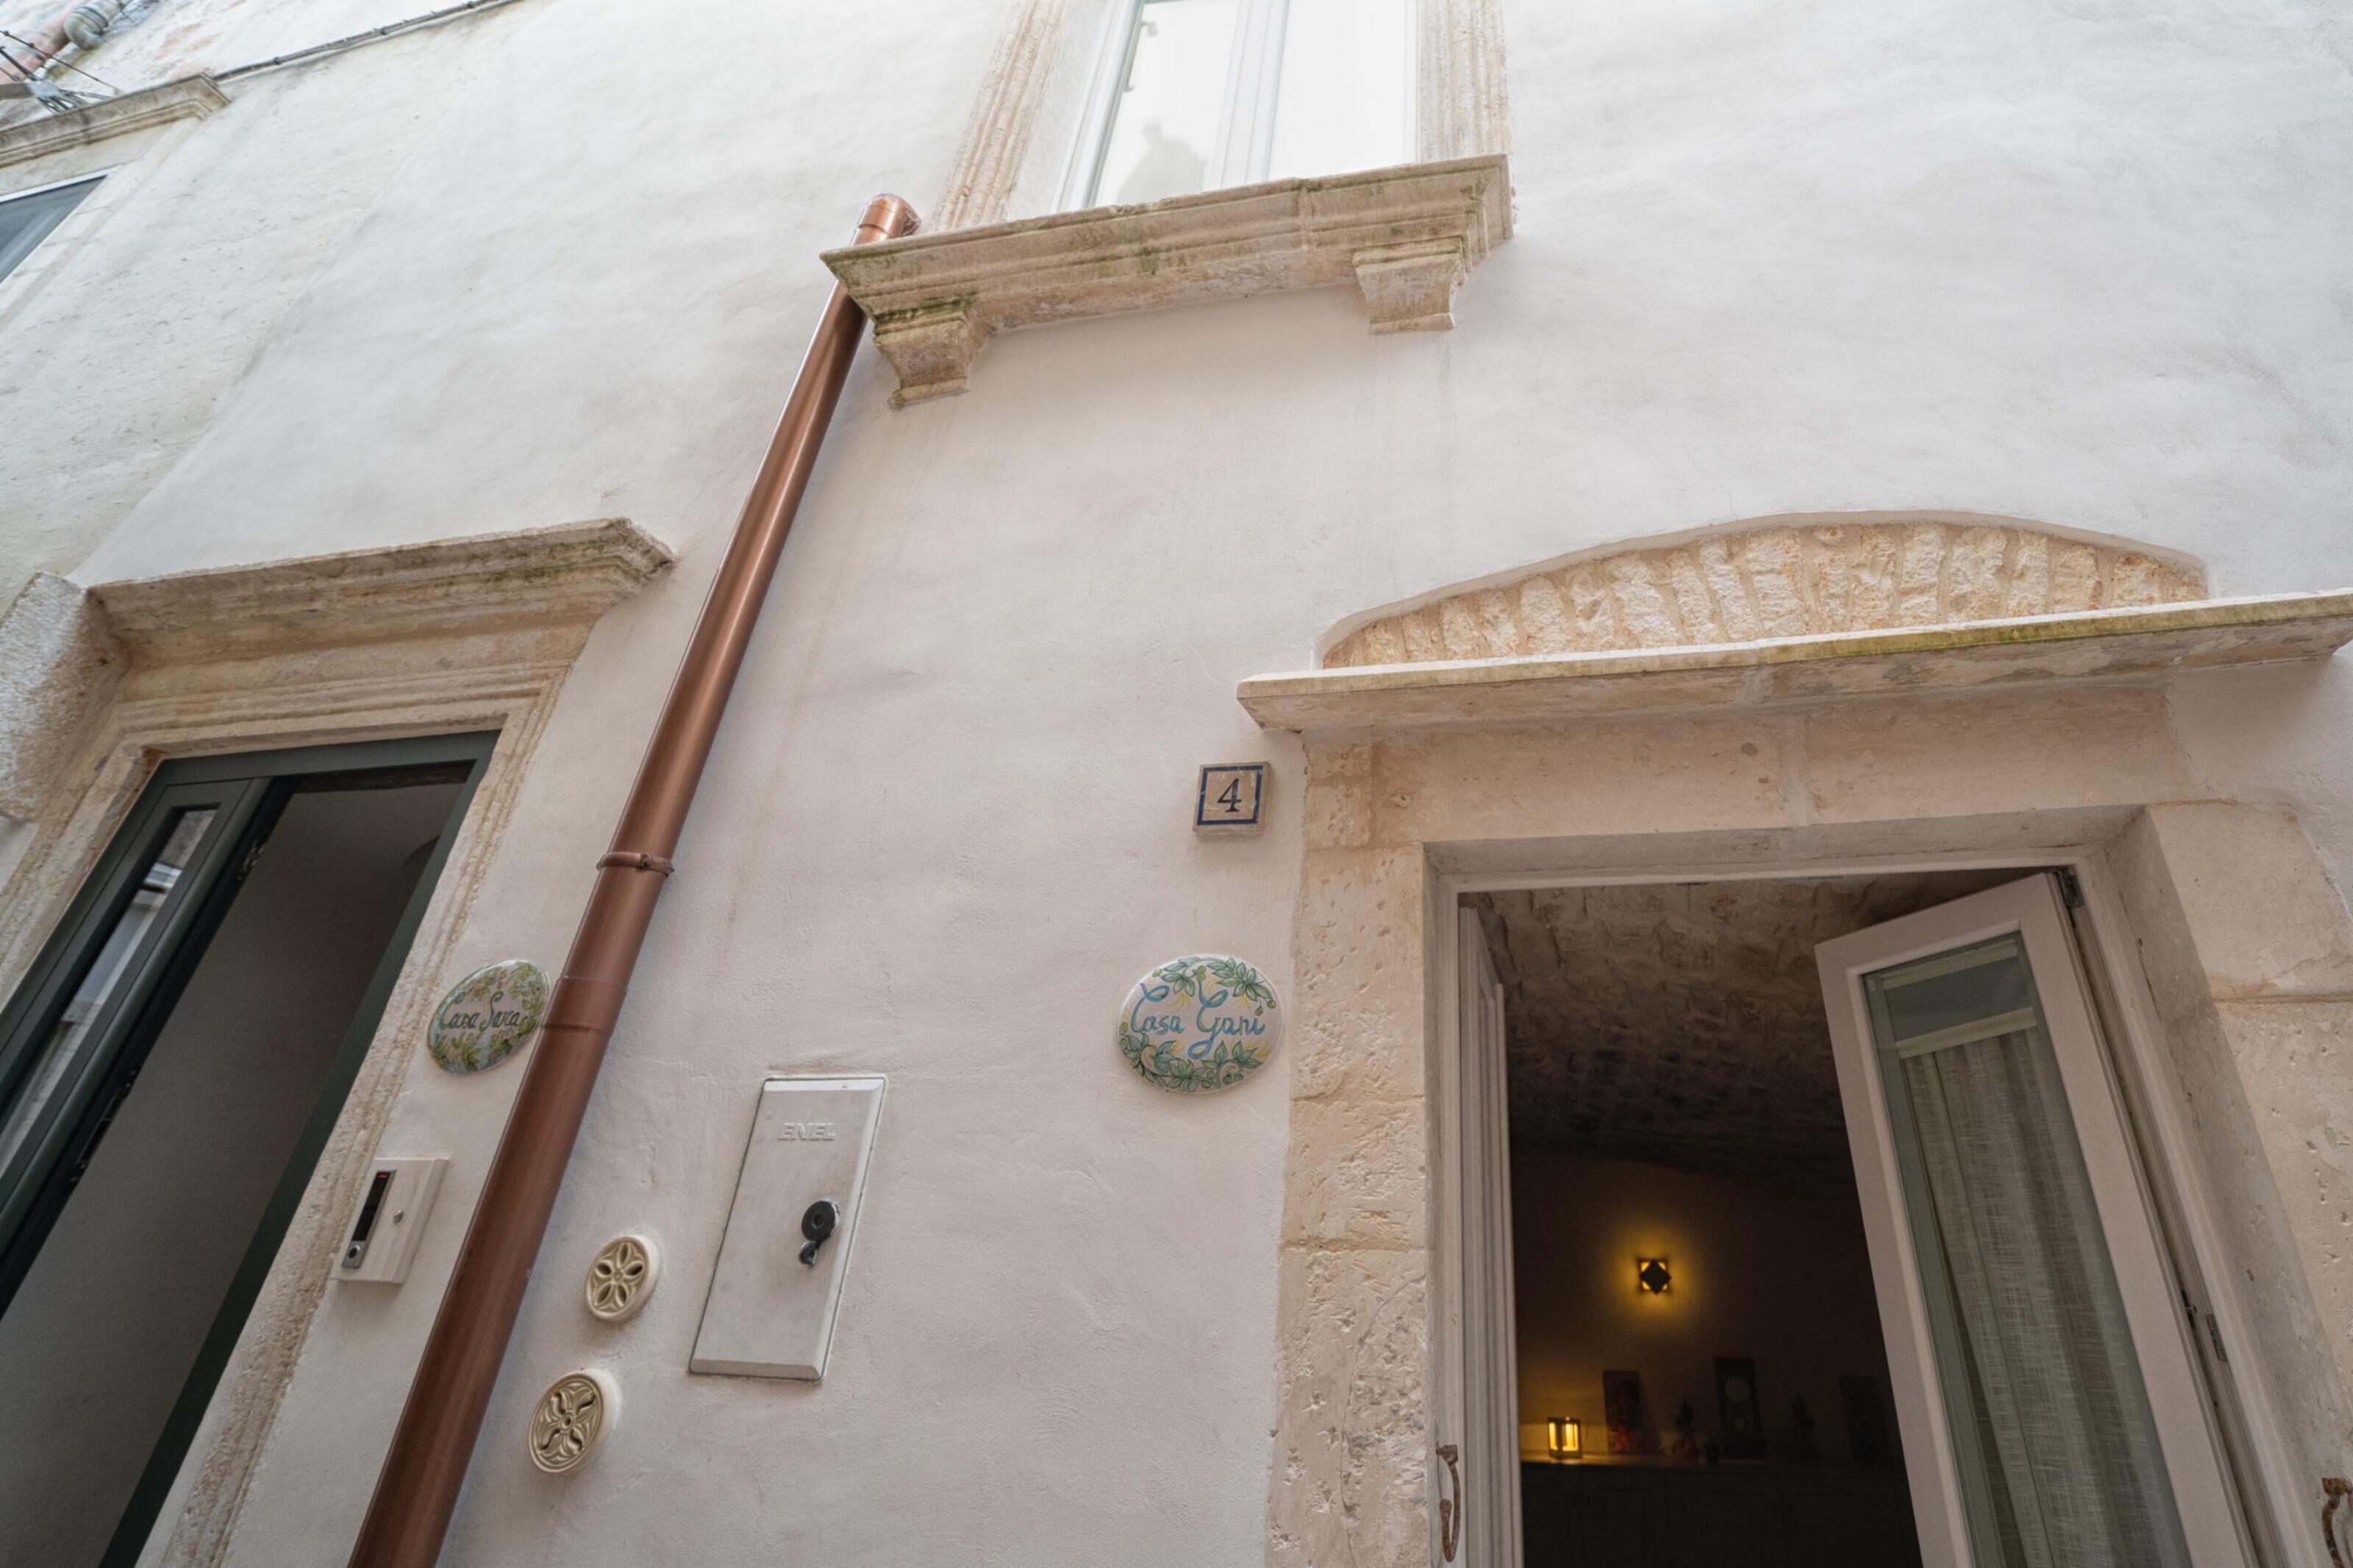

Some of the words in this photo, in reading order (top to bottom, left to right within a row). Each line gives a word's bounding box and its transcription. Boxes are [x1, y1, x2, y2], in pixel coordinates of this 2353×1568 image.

[1217, 778, 1243, 812] 4
[1130, 981, 1185, 1035] Casa
[777, 1123, 836, 1141] ENEL
